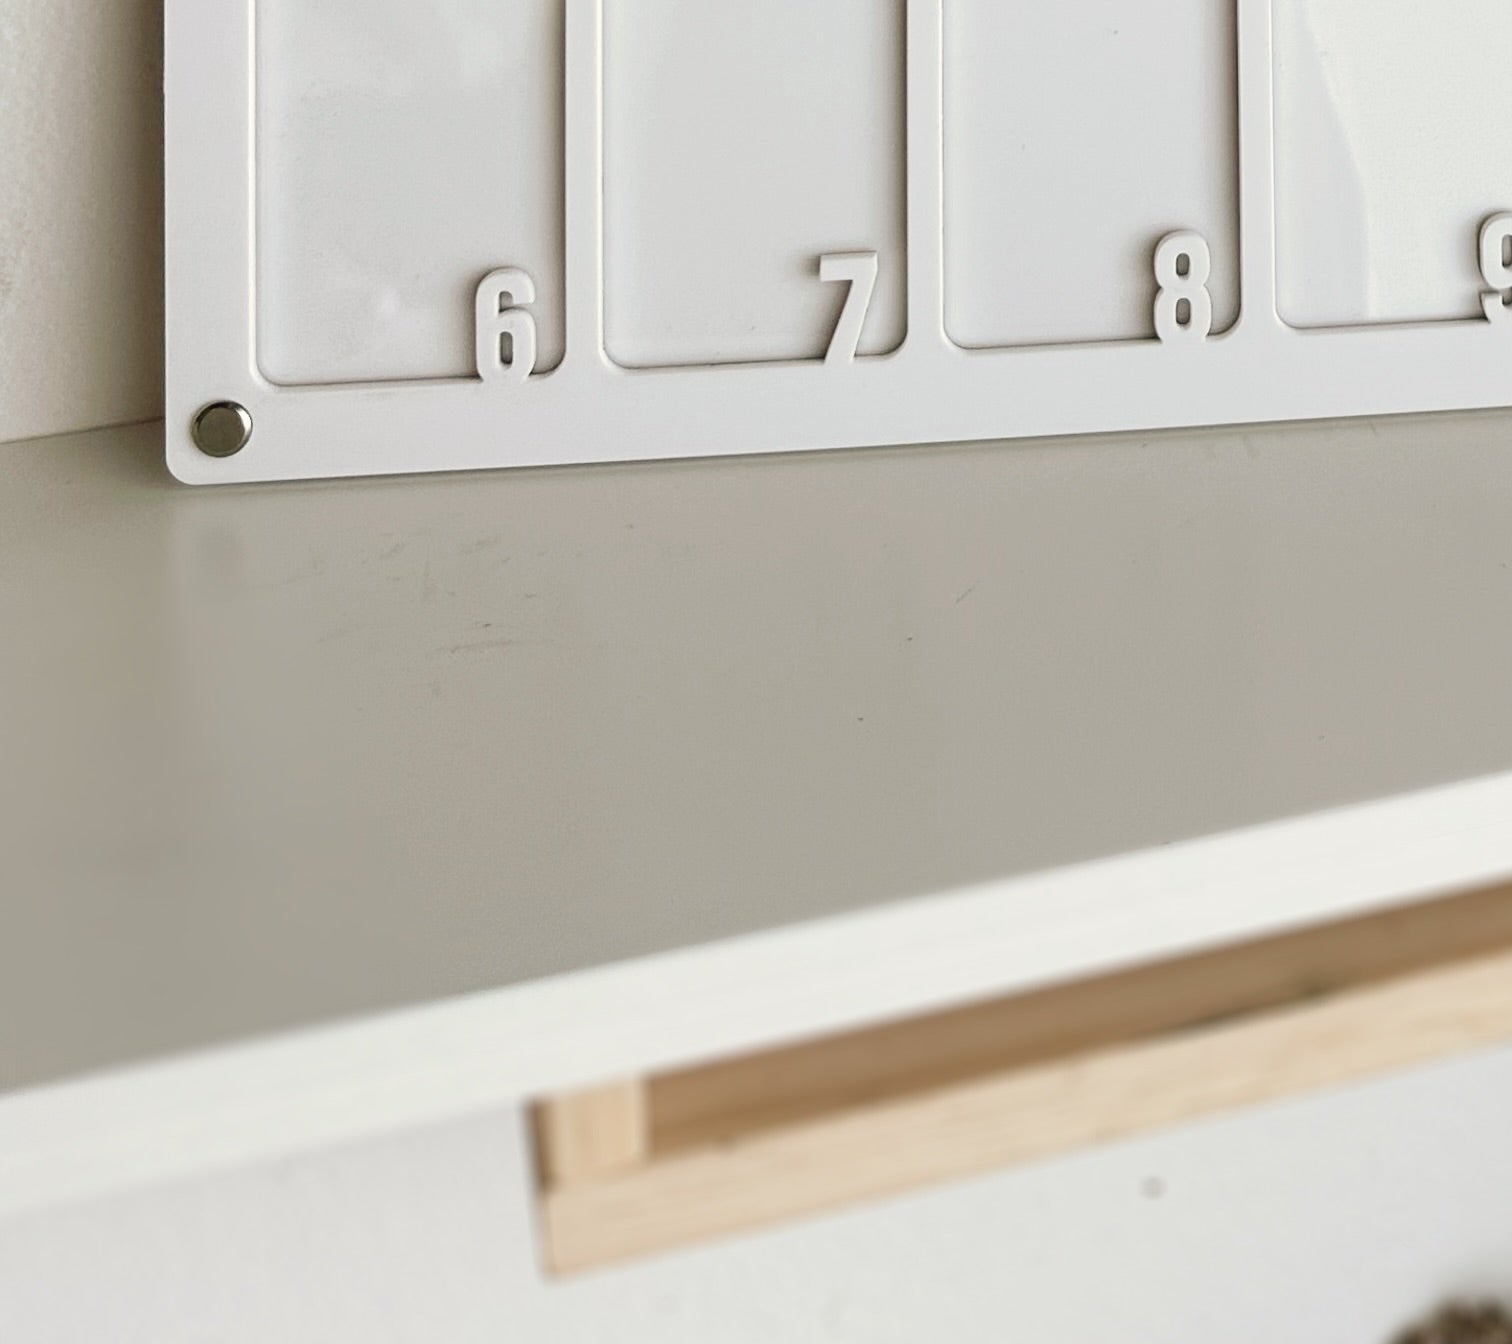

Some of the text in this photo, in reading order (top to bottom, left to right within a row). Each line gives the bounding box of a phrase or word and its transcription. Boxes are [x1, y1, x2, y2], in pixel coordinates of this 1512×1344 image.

[474, 265, 536, 382] 6
[818, 250, 878, 365] 7
[1153, 229, 1212, 343] 8
